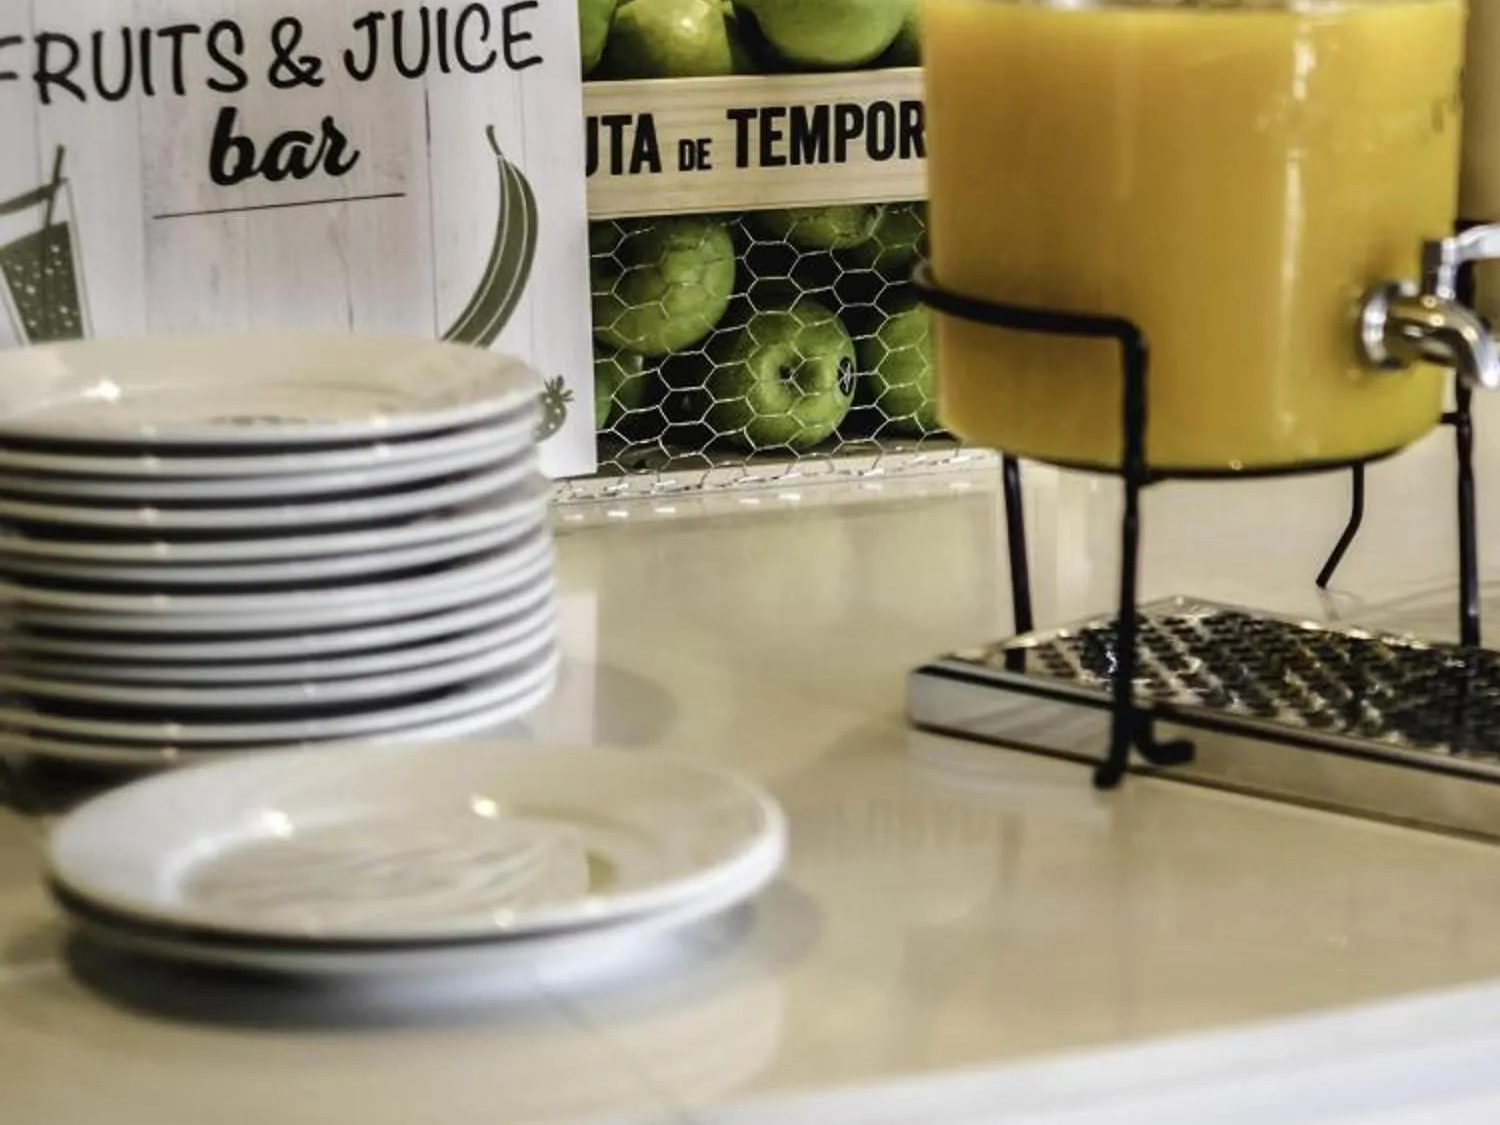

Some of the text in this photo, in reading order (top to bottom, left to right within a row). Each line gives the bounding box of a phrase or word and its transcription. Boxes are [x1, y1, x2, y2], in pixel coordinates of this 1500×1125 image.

[267, 16, 325, 89] &
[343, 0, 543, 81] JUICE
[209, 106, 361, 187] bar
[678, 138, 713, 172] DE
[726, 99, 926, 169] TEMPOR
